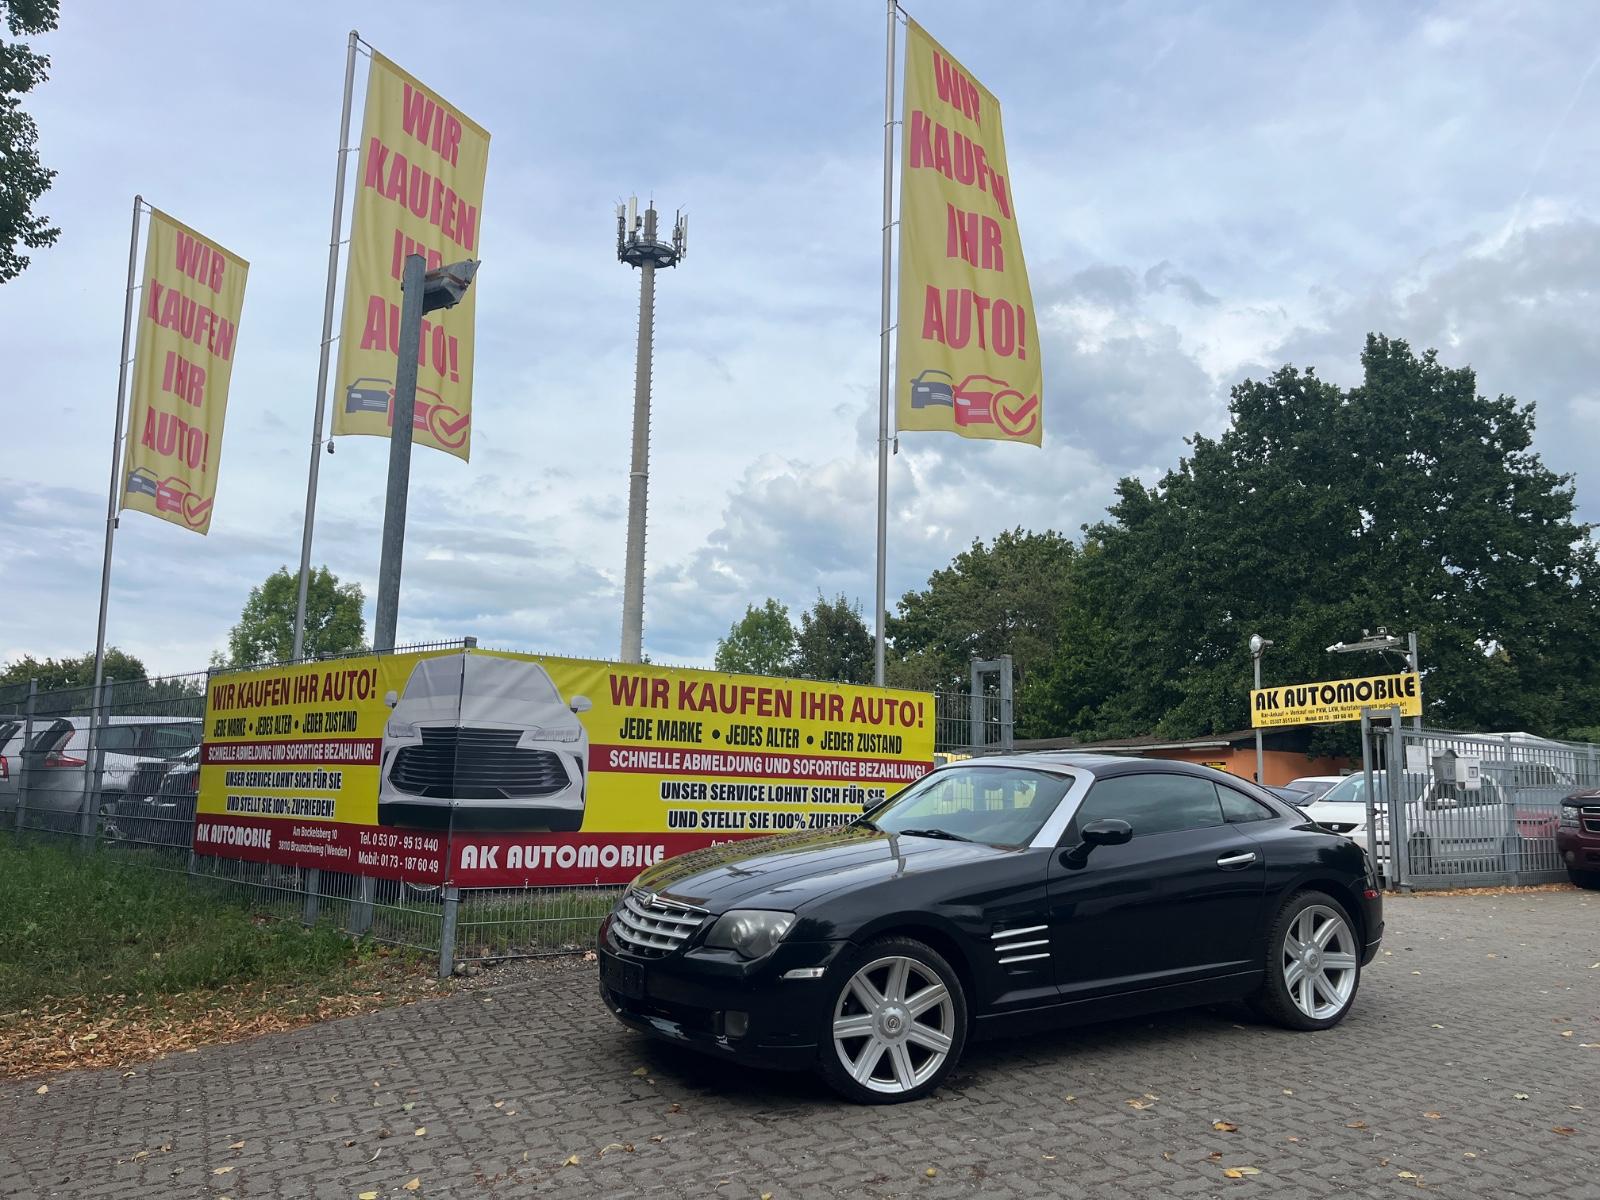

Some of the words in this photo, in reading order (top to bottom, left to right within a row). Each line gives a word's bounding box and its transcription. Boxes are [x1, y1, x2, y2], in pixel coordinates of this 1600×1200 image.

[933, 50, 981, 127] WIR
[402, 82, 462, 168] WIR
[364, 137, 476, 251] KAUFEN
[947, 202, 1004, 272] IHR
[176, 230, 225, 294] WIR
[147, 278, 234, 361] KAUFEN
[921, 285, 1026, 361] AUTO!
[162, 350, 205, 408] IHR
[141, 405, 208, 473] AUTO!
[213, 684, 236, 711] WIR
[237, 678, 290, 709] KAUFEN
[294, 674, 318, 704] IHR
[322, 668, 377, 702] AUTO!
[610, 675, 670, 709] WIR
[678, 680, 792, 718] KAUFEN
[801, 692, 844, 722] IHR
[850, 696, 924, 728] AUTO!
[1256, 691, 1278, 710] AK
[1285, 677, 1415, 708] AUTOMOBILE
[214, 718, 226, 737] JEDE
[228, 718, 246, 737] MARKE
[256, 716, 272, 736] JEDES
[274, 714, 292, 734] ALTER
[302, 712, 323, 733] JEDER
[324, 711, 357, 732] ZUSTAND
[620, 717, 652, 740] JEDE
[657, 719, 702, 743] MARKE
[726, 725, 763, 747] JEDES
[766, 727, 799, 748] ALTER
[821, 731, 854, 751] JEDER
[857, 732, 902, 754] ZUSTAND
[208, 747, 236, 761] SCHNELLE
[236, 745, 272, 761] ABMELDUNG
[272, 745, 286, 760] UND
[287, 744, 324, 761] SOFORTIGE
[325, 743, 373, 760] BEZAHLUNG!
[609, 750, 681, 769] SCHNELLE
[683, 754, 762, 774] ABMELDUNG
[764, 758, 790, 775] UND
[793, 759, 856, 777] SOFORTIGE
[859, 762, 926, 779] BEZAHLUNG!
[226, 771, 245, 787] UNSER
[246, 772, 271, 787] SERVICE
[272, 772, 294, 788] LOHNT
[294, 772, 311, 789] SICH
[312, 769, 328, 789] FÜR
[329, 772, 341, 790] SIE
[661, 782, 707, 800] UNSER
[710, 784, 765, 802] SERVICE
[768, 786, 808, 803] LOHNT
[811, 788, 839, 803] SICH
[843, 785, 864, 803] FÜR
[227, 796, 240, 811] UND
[241, 796, 260, 812] STELLT
[262, 797, 272, 813] SIE
[273, 798, 290, 815] 100%
[292, 798, 334, 817] ZUFRIEDEN!
[668, 811, 698, 828] UND
[701, 811, 747, 828] STELLT
[749, 813, 769, 829] SIE
[772, 813, 806, 829] 100%
[197, 824, 210, 841] AK
[211, 825, 272, 849] AUTOMOBILE
[291, 841, 324, 856] Braunschweig
[332, 829, 337, 840] 10
[360, 832, 371, 845] Tel.
[373, 833, 377, 845] 0
[379, 834, 388, 846] 53
[389, 835, 398, 847] 07
[403, 837, 413, 849] 95
[414, 837, 422, 850] 13
[424, 838, 438, 852] 440
[358, 851, 379, 866] Mobil:
[405, 857, 417, 870] 187
[418, 858, 427, 871] 60
[429, 860, 438, 873] 49
[460, 845, 500, 869] AK
[506, 845, 664, 869] AUTOMOBILE
